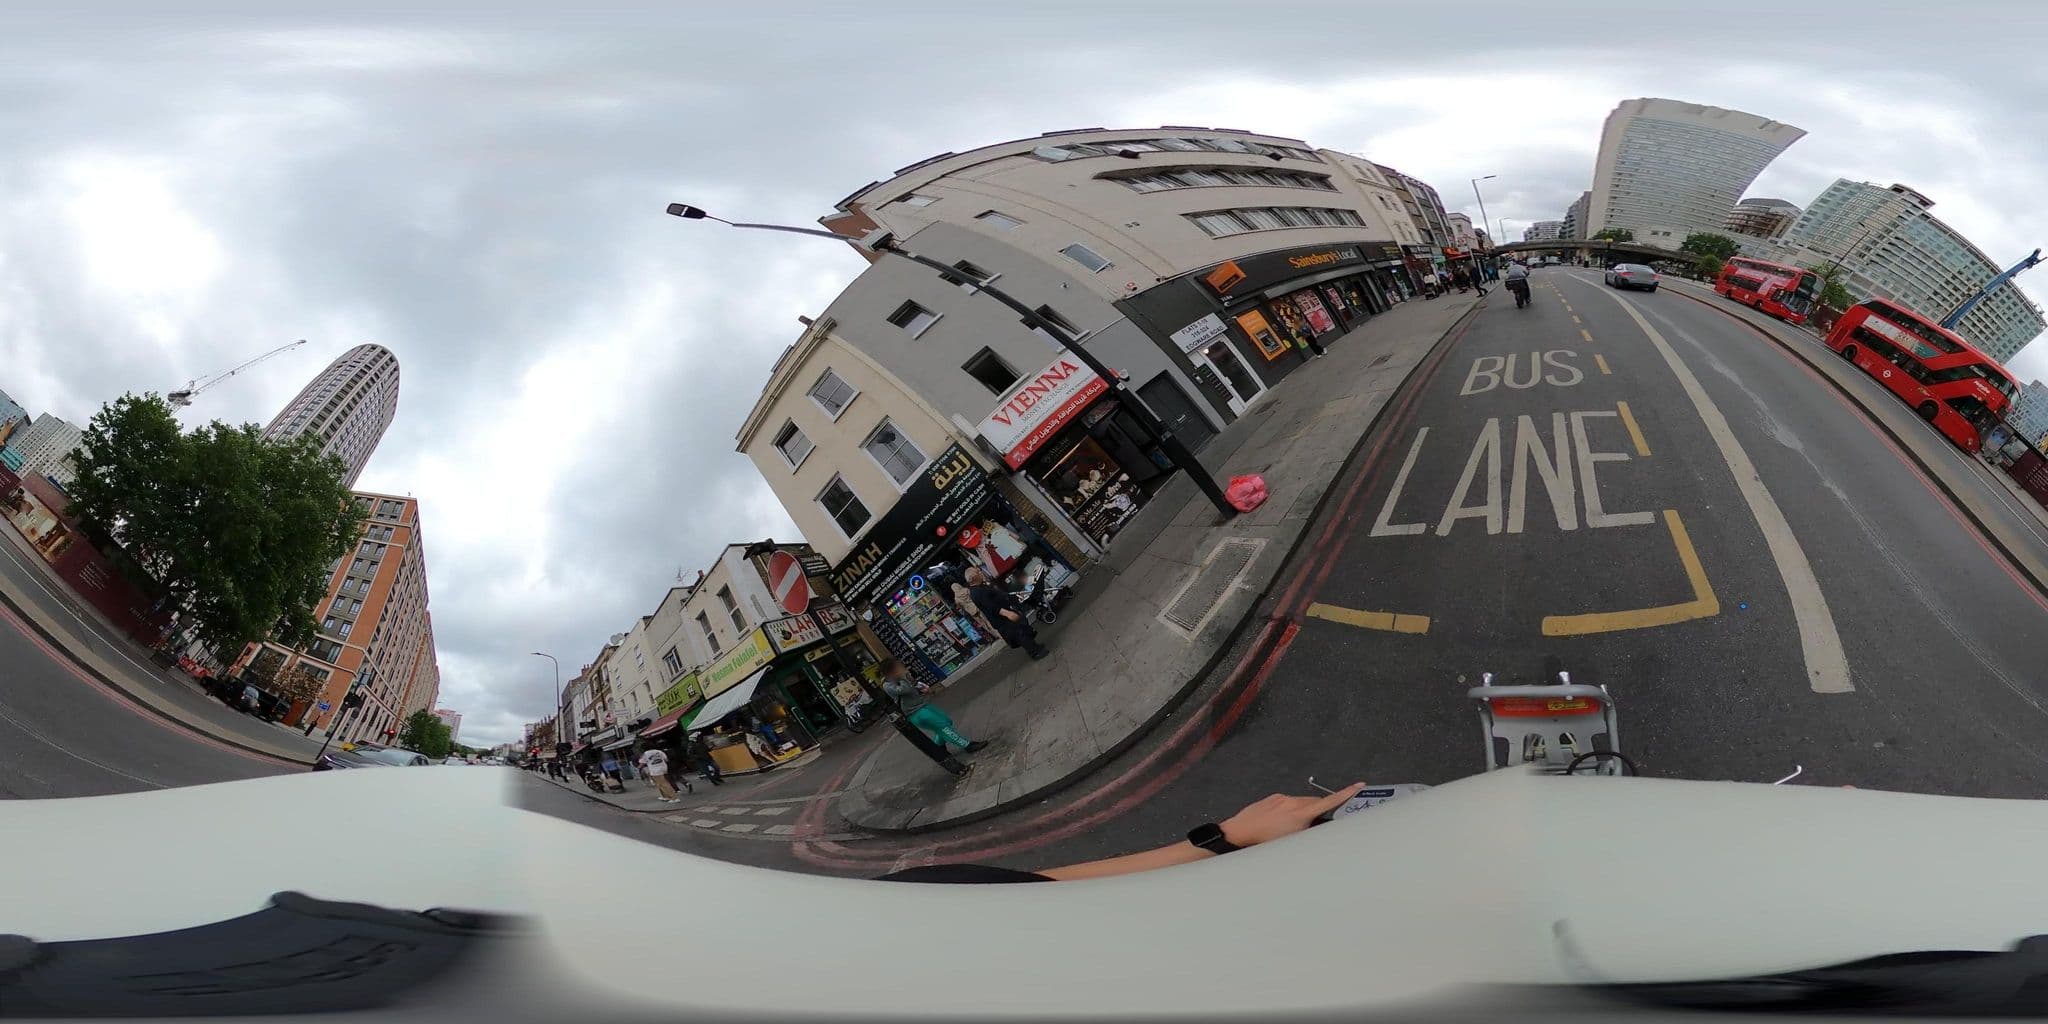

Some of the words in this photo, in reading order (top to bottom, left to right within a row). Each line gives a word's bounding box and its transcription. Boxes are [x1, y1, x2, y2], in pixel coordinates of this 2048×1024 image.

[1289, 251, 1339, 269] Sainsbury's
[1338, 248, 1357, 261] Local
[992, 360, 1079, 425] VIENNA
[1460, 350, 1584, 396] BUS
[931, 451, 971, 490] زينة
[1368, 411, 1655, 537] LANE
[833, 541, 882, 595] ZINAH
[910, 544, 924, 558] SHOP
[785, 609, 837, 634] LAHRE
